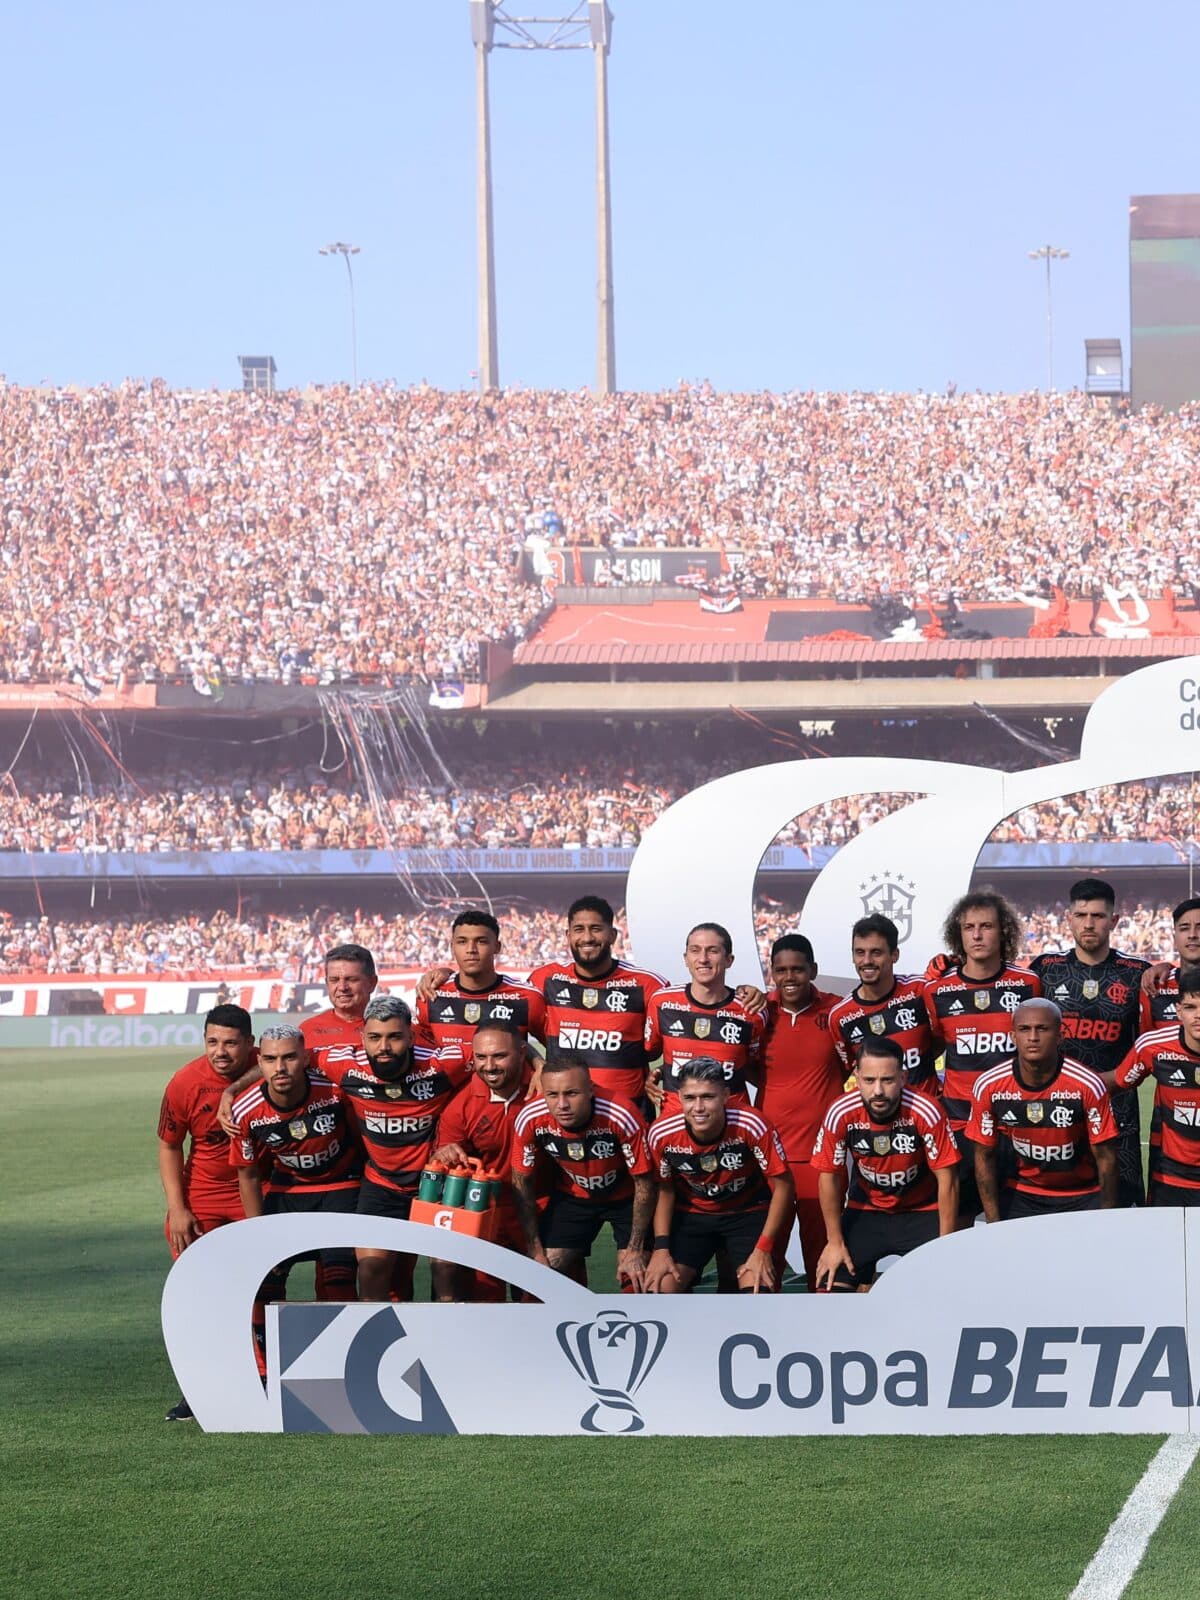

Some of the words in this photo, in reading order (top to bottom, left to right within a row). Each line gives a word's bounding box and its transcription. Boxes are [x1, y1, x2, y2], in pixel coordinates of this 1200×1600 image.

[606, 978, 638, 989] pixbet
[937, 983, 967, 996] pixbet
[995, 978, 1025, 989] pixbet
[488, 992, 521, 1001] pixbet
[887, 991, 917, 1009] pixbet
[661, 1001, 692, 1012] pixbet
[716, 1010, 746, 1021] pixbet
[839, 1008, 865, 1028] pixbet
[50, 1018, 204, 1047] intelbra
[1078, 1019, 1121, 1041] BRB
[577, 1029, 622, 1051] BRB
[308, 1095, 339, 1113] pixbet
[992, 1090, 1022, 1103] pixbet
[1050, 1090, 1081, 1102] pixbet
[250, 1114, 282, 1129] pixbet
[387, 1115, 433, 1134] BRB
[299, 1138, 341, 1169] BRB
[1031, 1142, 1075, 1162] BRB
[575, 1170, 617, 1190] BRB
[876, 1164, 918, 1187] BRB
[469, 1188, 481, 1202] G
[718, 1332, 928, 1423] Copa
